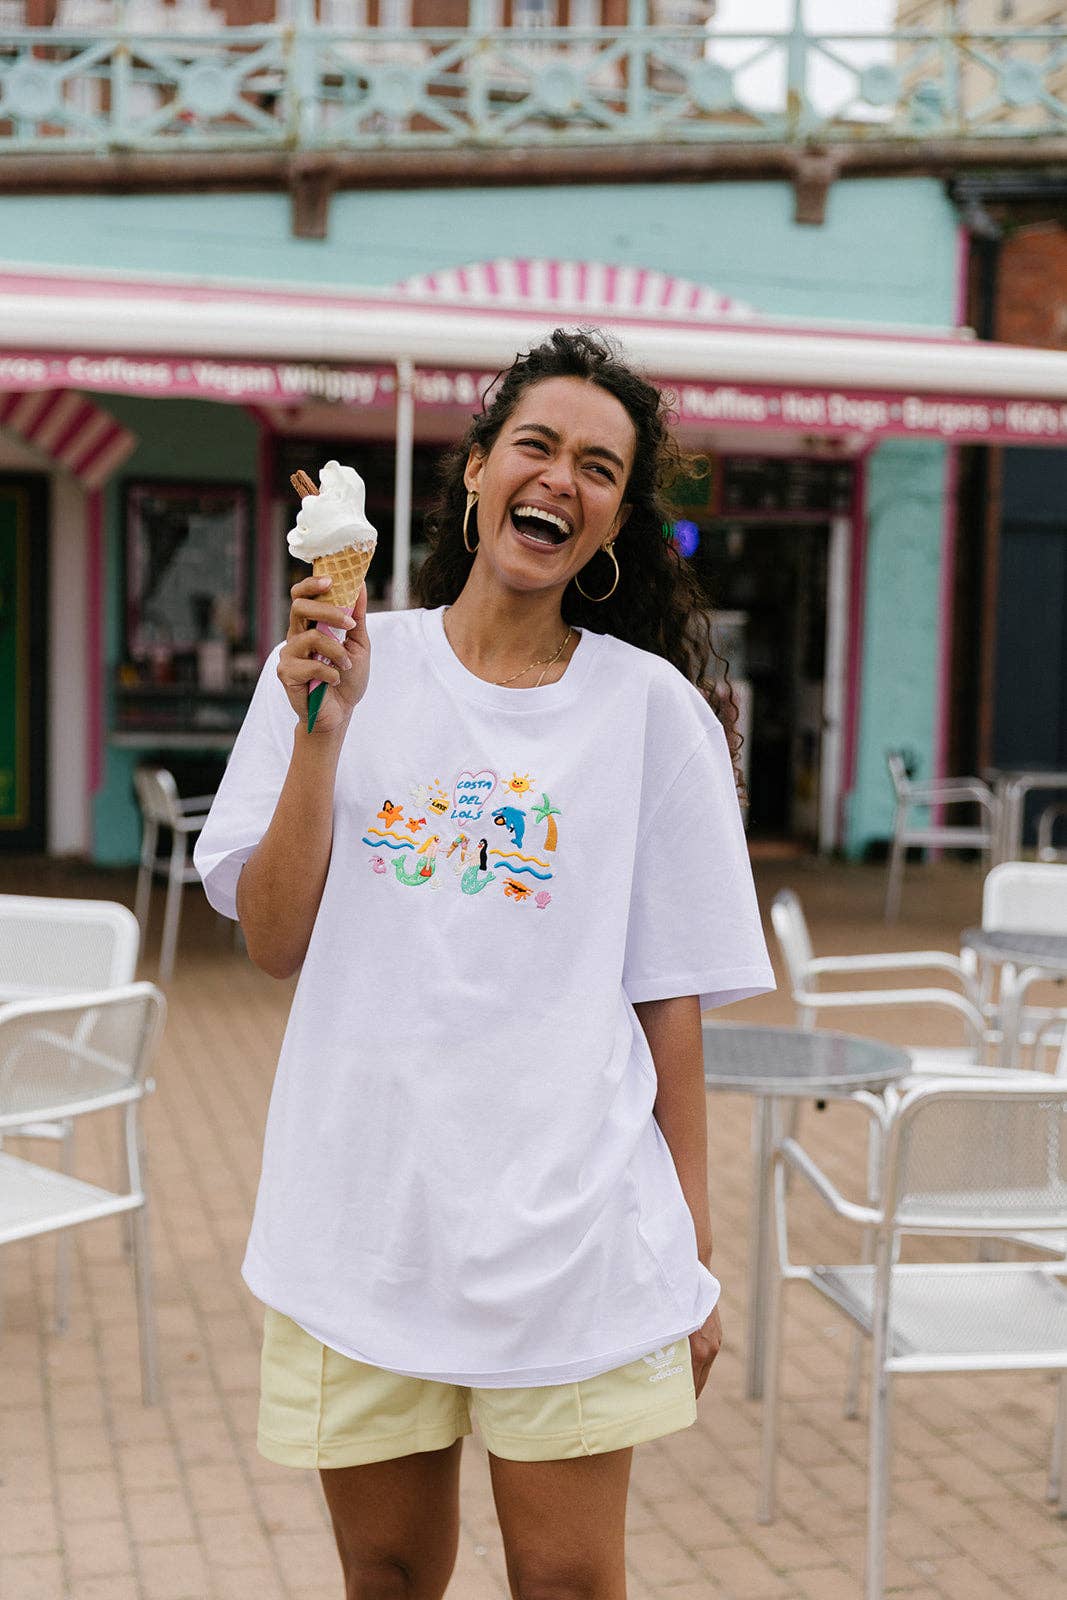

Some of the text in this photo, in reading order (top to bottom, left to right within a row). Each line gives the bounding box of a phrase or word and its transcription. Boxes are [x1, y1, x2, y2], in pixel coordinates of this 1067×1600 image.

[66, 356, 171, 387] Coffees
[192, 361, 276, 395] Vegan
[277, 364, 376, 404] Whippy
[682, 385, 768, 422] Muffins
[781, 391, 826, 425] Hot
[828, 393, 889, 431] Dogs
[903, 396, 991, 436] Burgers
[457, 780, 492, 789] COSTA
[458, 795, 482, 805] DEL
[451, 810, 482, 820] LOLS
